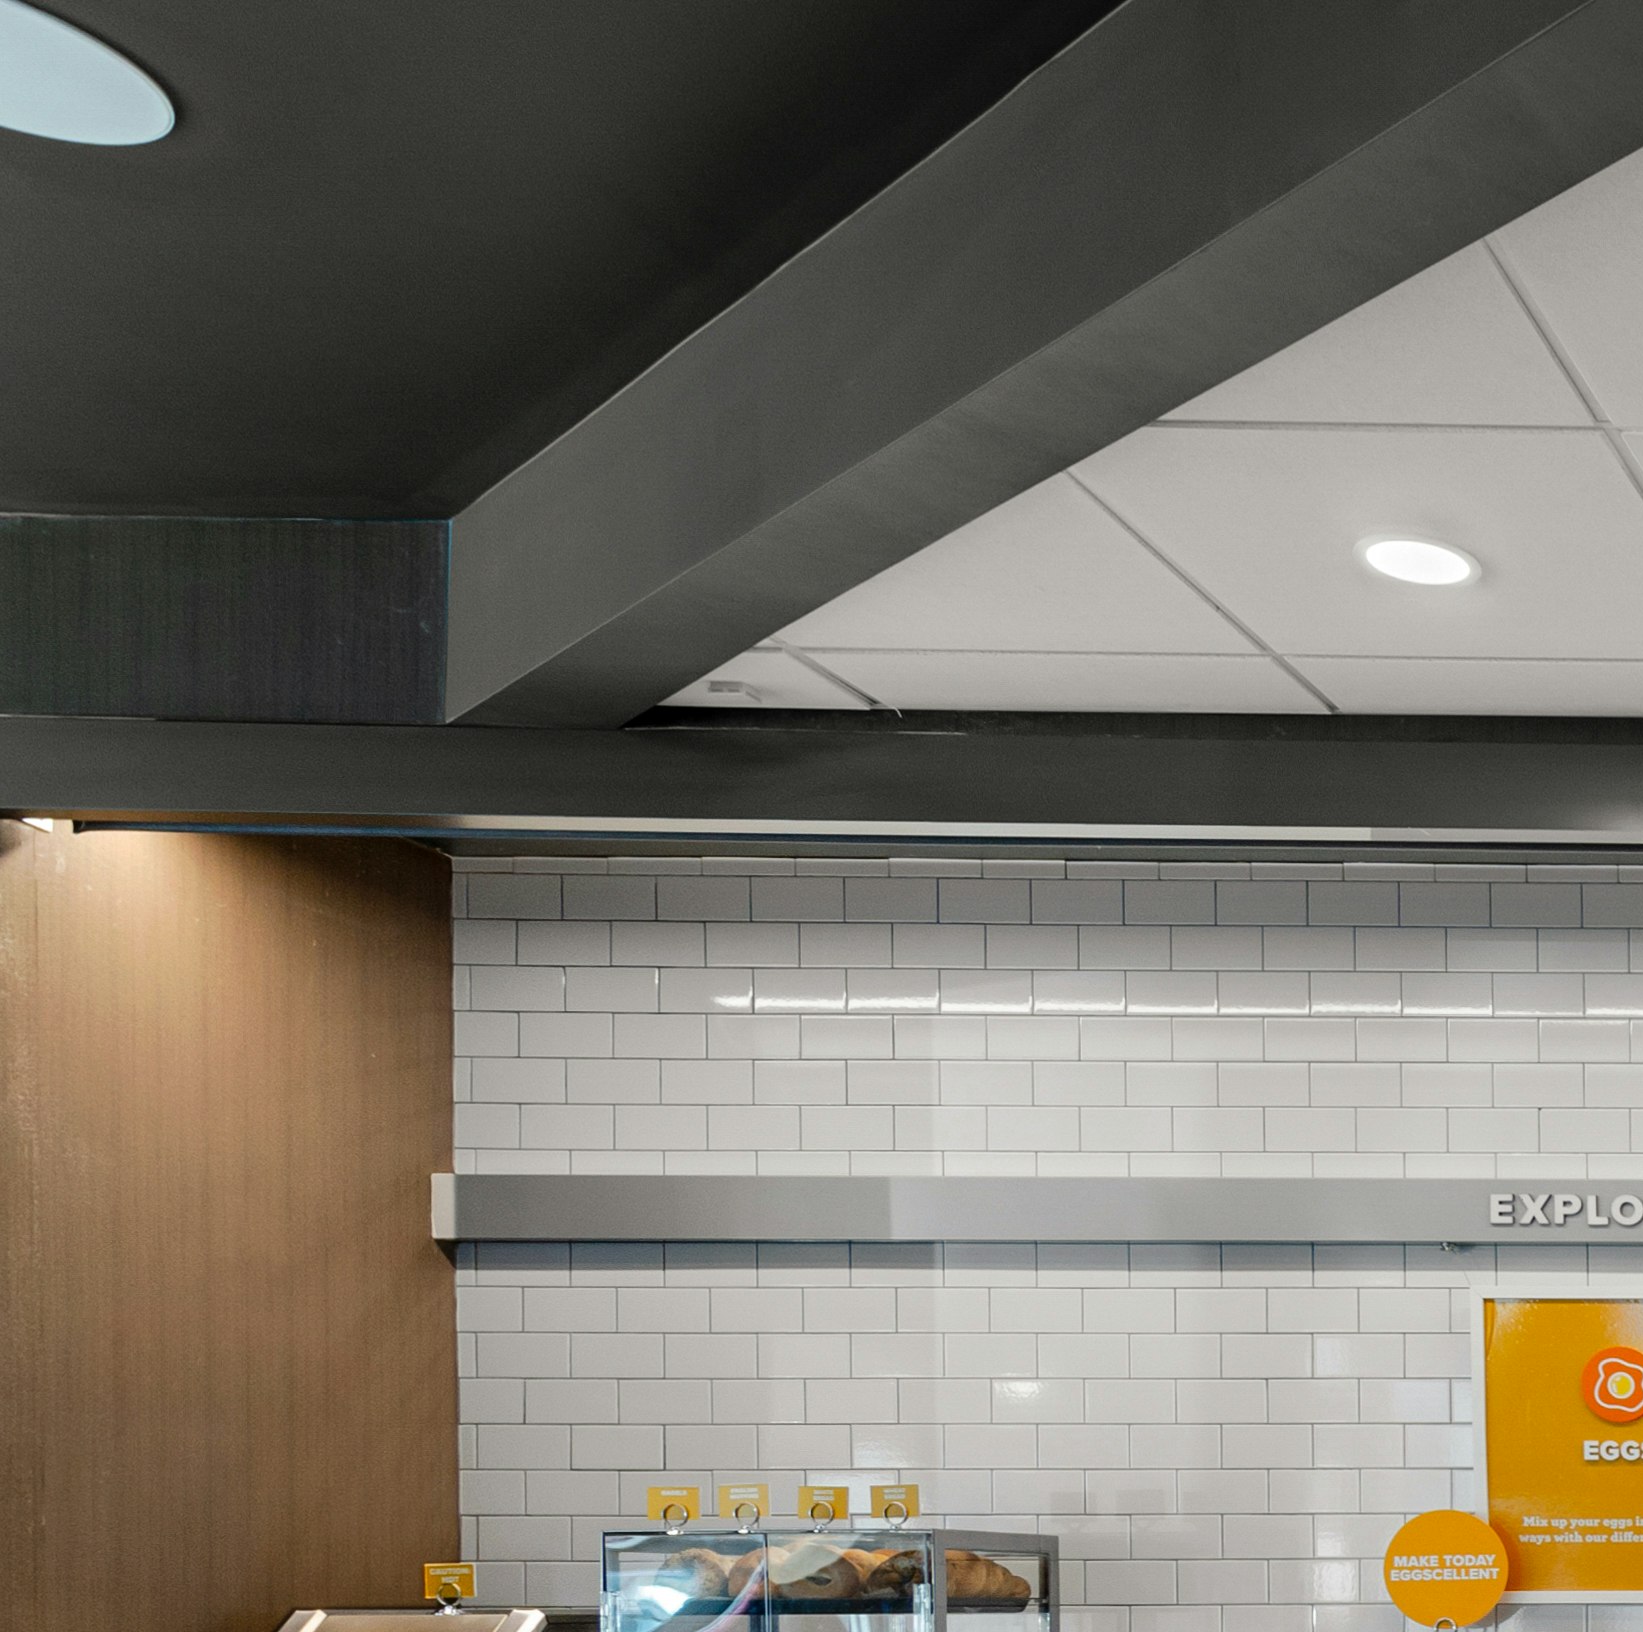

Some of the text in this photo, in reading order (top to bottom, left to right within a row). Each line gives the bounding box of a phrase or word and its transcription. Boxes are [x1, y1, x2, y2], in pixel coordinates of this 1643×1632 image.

[1522, 1516, 1548, 1527] Mix
[1551, 1518, 1567, 1529] up
[1570, 1518, 1600, 1529] your
[1603, 1518, 1633, 1529] eggs
[1519, 1534, 1551, 1544] ways
[1554, 1532, 1583, 1543] with
[1585, 1533, 1608, 1543] our
[1393, 1554, 1497, 1567] MAKE TODAY
[1390, 1568, 1500, 1581] EGGSCELLENT
